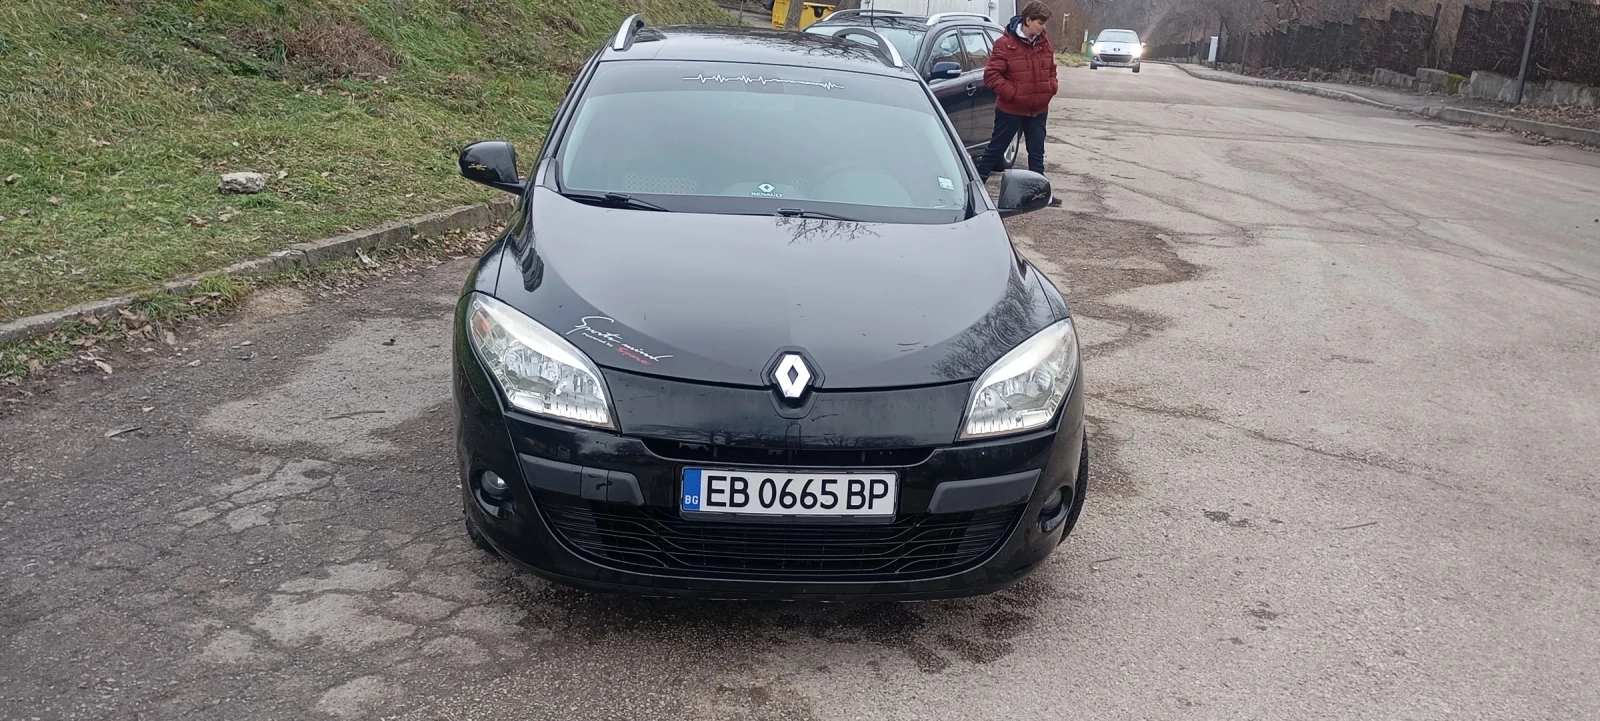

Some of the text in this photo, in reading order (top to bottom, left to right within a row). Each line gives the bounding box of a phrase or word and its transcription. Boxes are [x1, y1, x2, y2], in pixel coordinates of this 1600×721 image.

[684, 495, 699, 505] BG
[706, 475, 889, 510] EB 0665 BP
